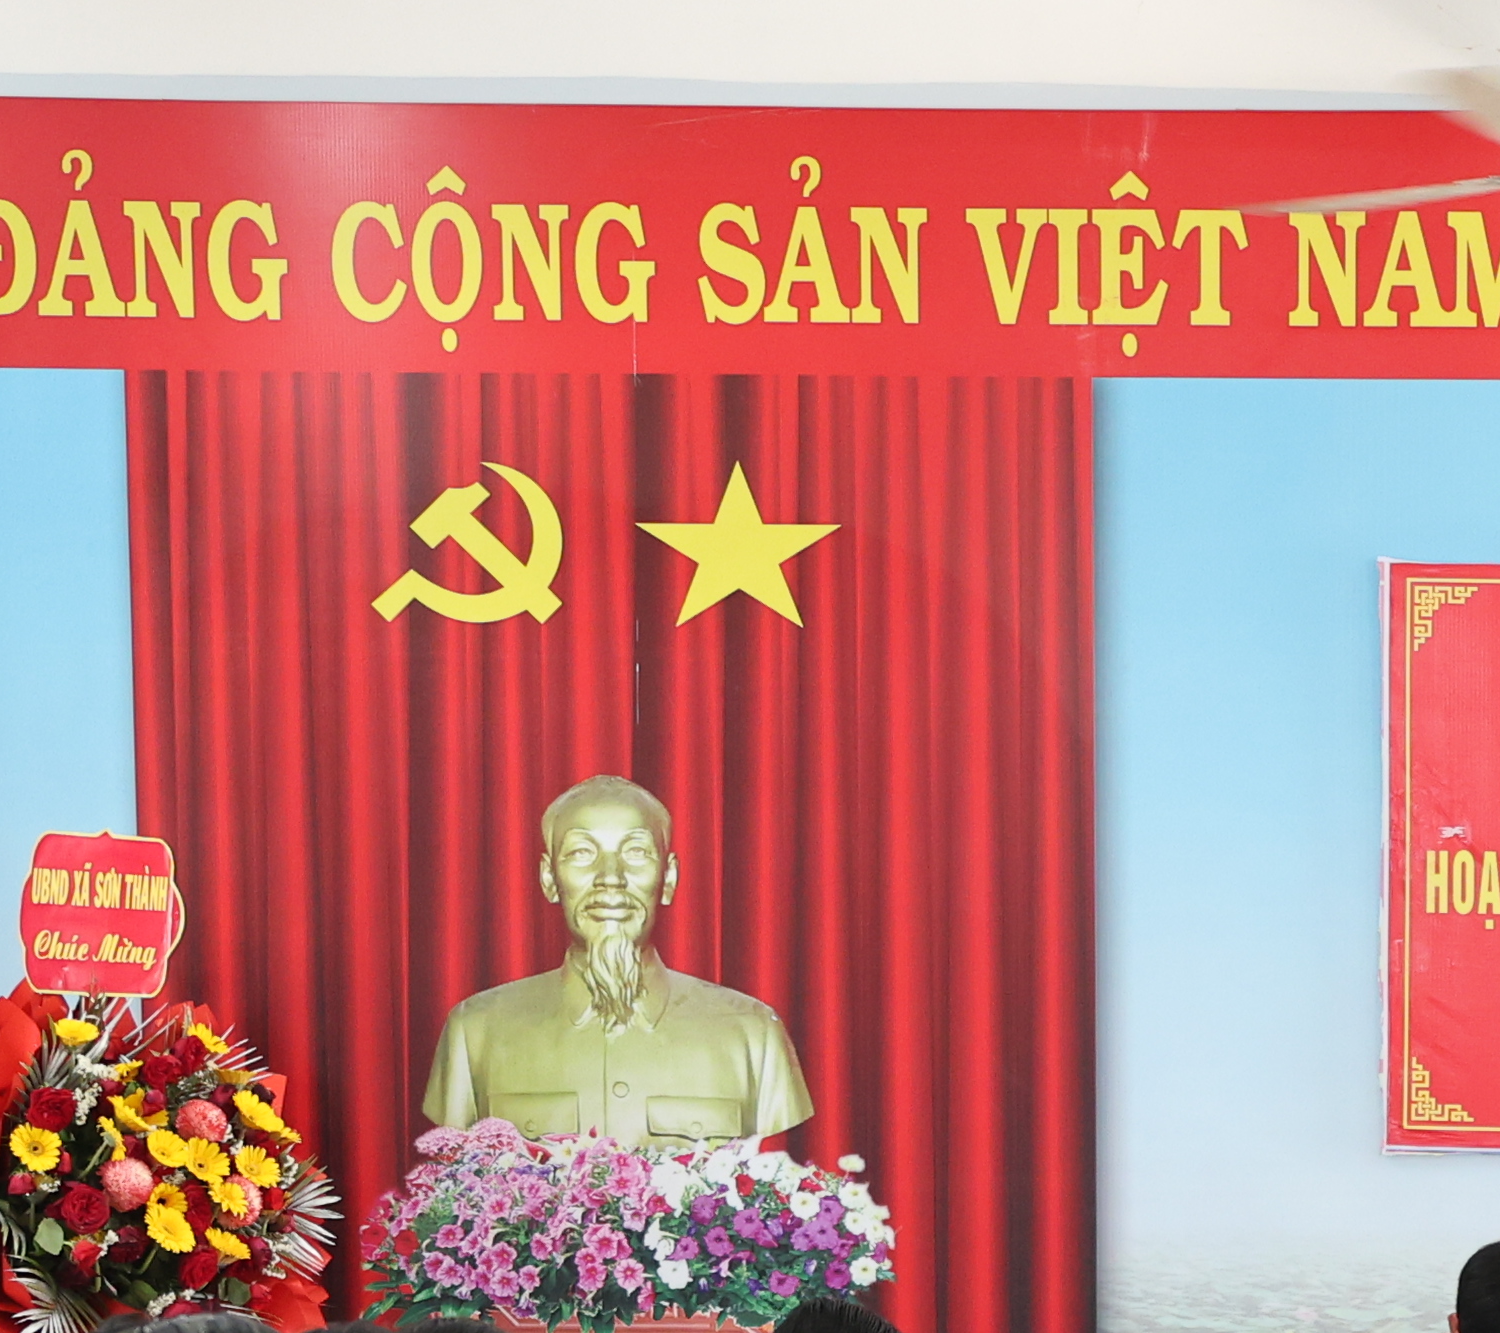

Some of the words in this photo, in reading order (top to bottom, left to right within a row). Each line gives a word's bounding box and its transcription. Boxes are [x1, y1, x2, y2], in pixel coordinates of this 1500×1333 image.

[331, 166, 656, 352] CỘNG
[697, 156, 928, 325] SẢN
[966, 171, 1248, 356] VIỆT
[31, 867, 70, 906] UBND
[71, 862, 92, 907] XÃ
[94, 866, 122, 909] SƠN
[124, 865, 168, 912] THÀNH
[33, 929, 89, 961] Chúc
[92, 933, 157, 971] Mừng
